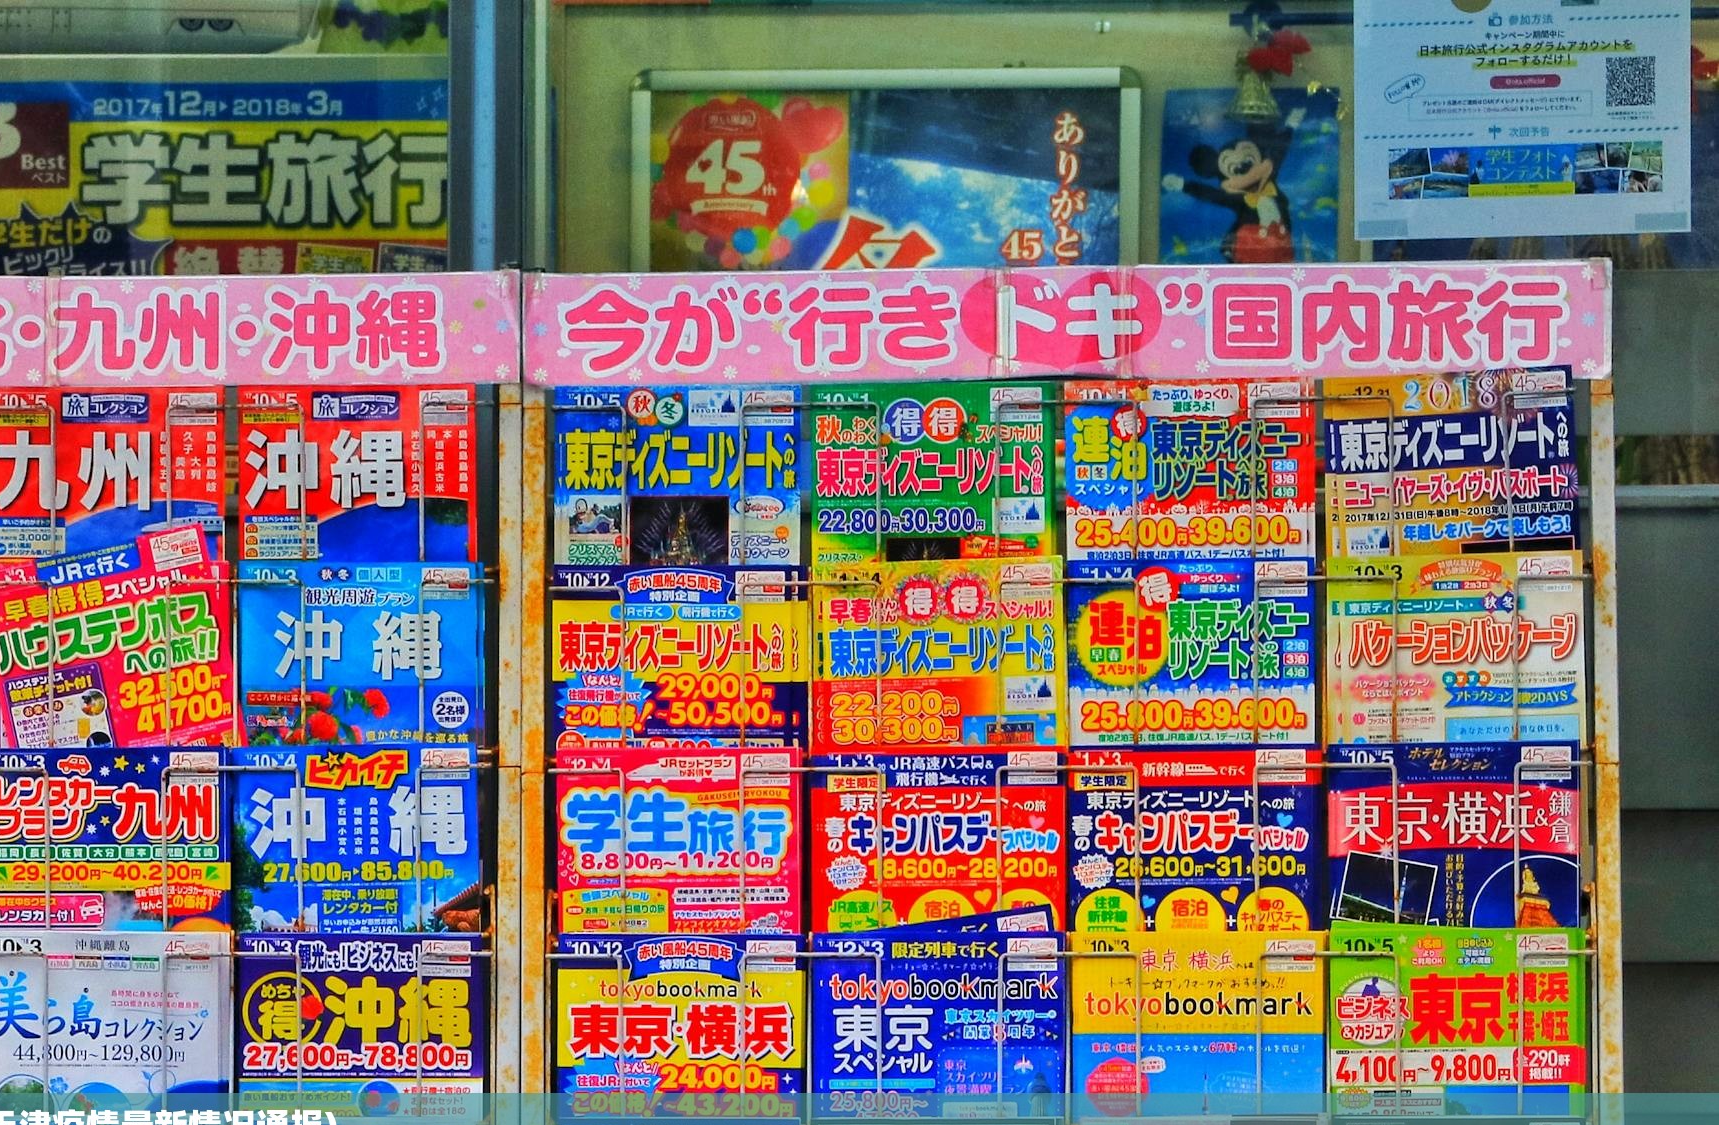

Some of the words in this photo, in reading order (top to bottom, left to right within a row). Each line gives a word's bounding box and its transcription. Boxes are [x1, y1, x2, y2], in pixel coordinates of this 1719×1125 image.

[1508, 14, 1553, 25] 参加方法
[1419, 39, 1632, 57] 日本旅行公式インスタグラムアカウントを
[1508, 125, 1550, 137] 次回予告
[21, 153, 65, 171] Best
[1485, 150, 1557, 165] 学生フォト
[33, 172, 65, 183] ベスト
[82, 131, 447, 226] 学生旅行
[1493, 166, 1557, 180] コンテスト
[1172, 401, 1216, 413] 遊ぼうよ!
[1152, 419, 1301, 462] 東京ディズニー
[245, 430, 406, 509] 沖縄
[50, 552, 130, 584] JRで行く
[629, 572, 721, 594] 赤い風船45周年
[649, 590, 700, 603] 特別企画
[1168, 600, 1309, 642] 東京ディズニー
[275, 610, 443, 682] 沖縄
[1350, 614, 1576, 667] バケーションパッケージ
[656, 674, 774, 700] 29,000円
[1080, 775, 1128, 788] 学生限定
[112, 784, 218, 841] 九州
[567, 790, 788, 857] 学生旅行
[1343, 792, 1535, 846] 東京・横浜
[323, 900, 397, 915] レンタカー付
[74, 939, 130, 952] 沖縄離島
[891, 941, 999, 959] 限定列車で行く
[830, 974, 1058, 1004] tokyobookmark
[325, 977, 472, 1049] 沖縄
[1410, 974, 1504, 1046] 東京
[570, 1002, 794, 1062] 東京・横浜
[832, 1006, 933, 1051] 東京
[660, 1065, 776, 1090] 24,000円
